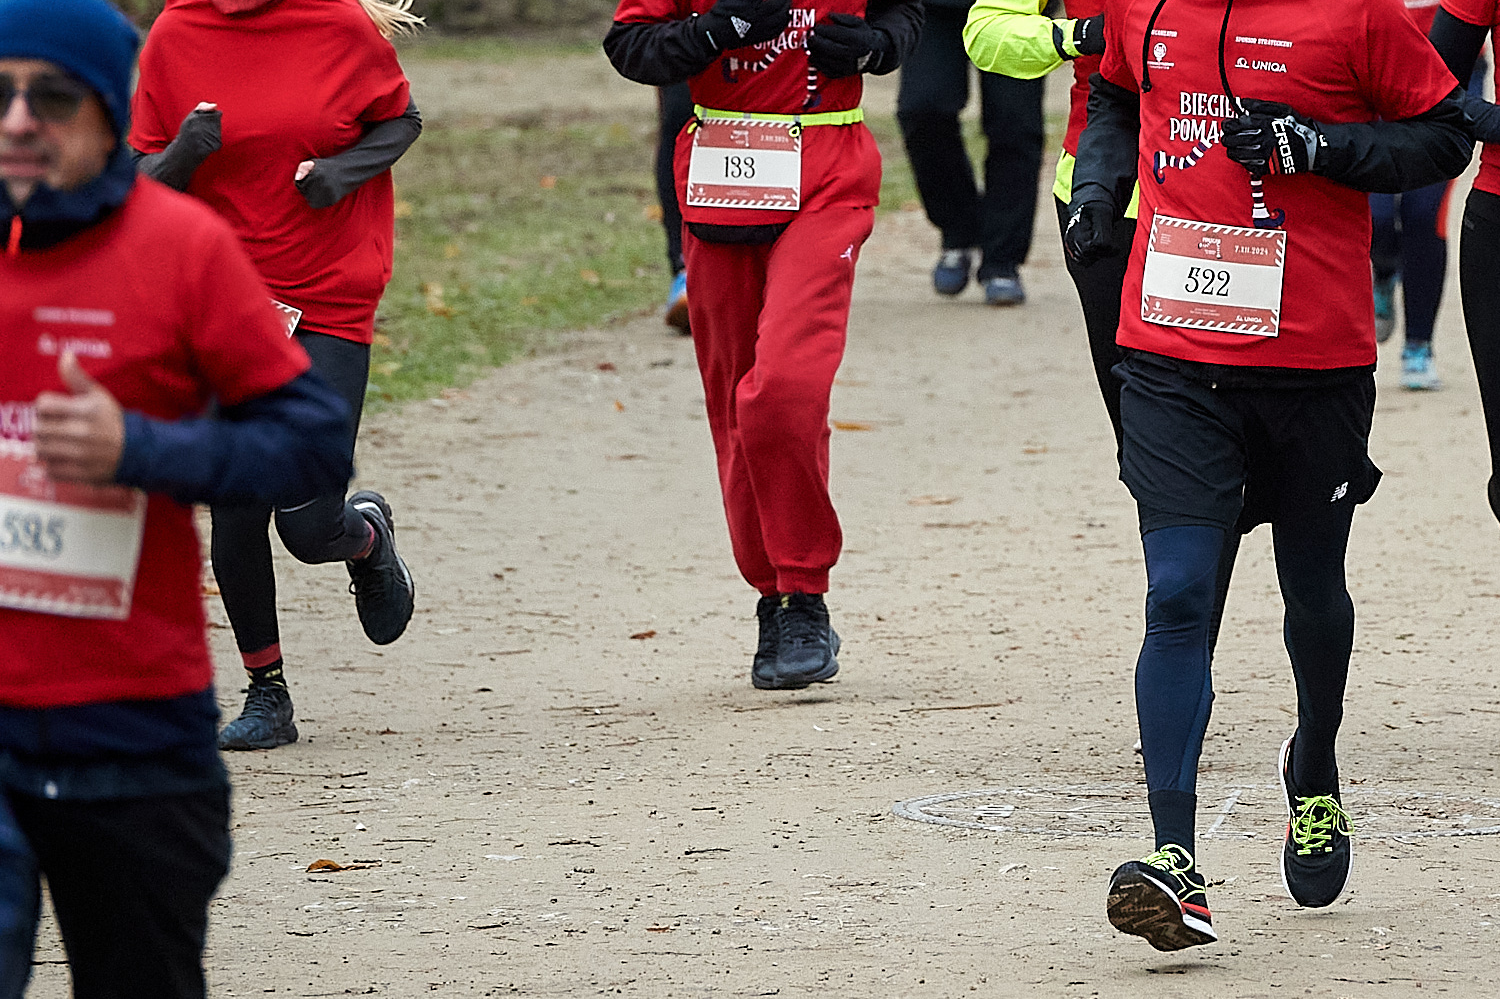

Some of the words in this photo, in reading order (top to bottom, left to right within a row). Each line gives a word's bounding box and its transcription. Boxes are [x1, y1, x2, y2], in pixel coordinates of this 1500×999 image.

[1252, 60, 1287, 73] UNIQA
[724, 156, 755, 178] 133
[1185, 267, 1231, 296] 522
